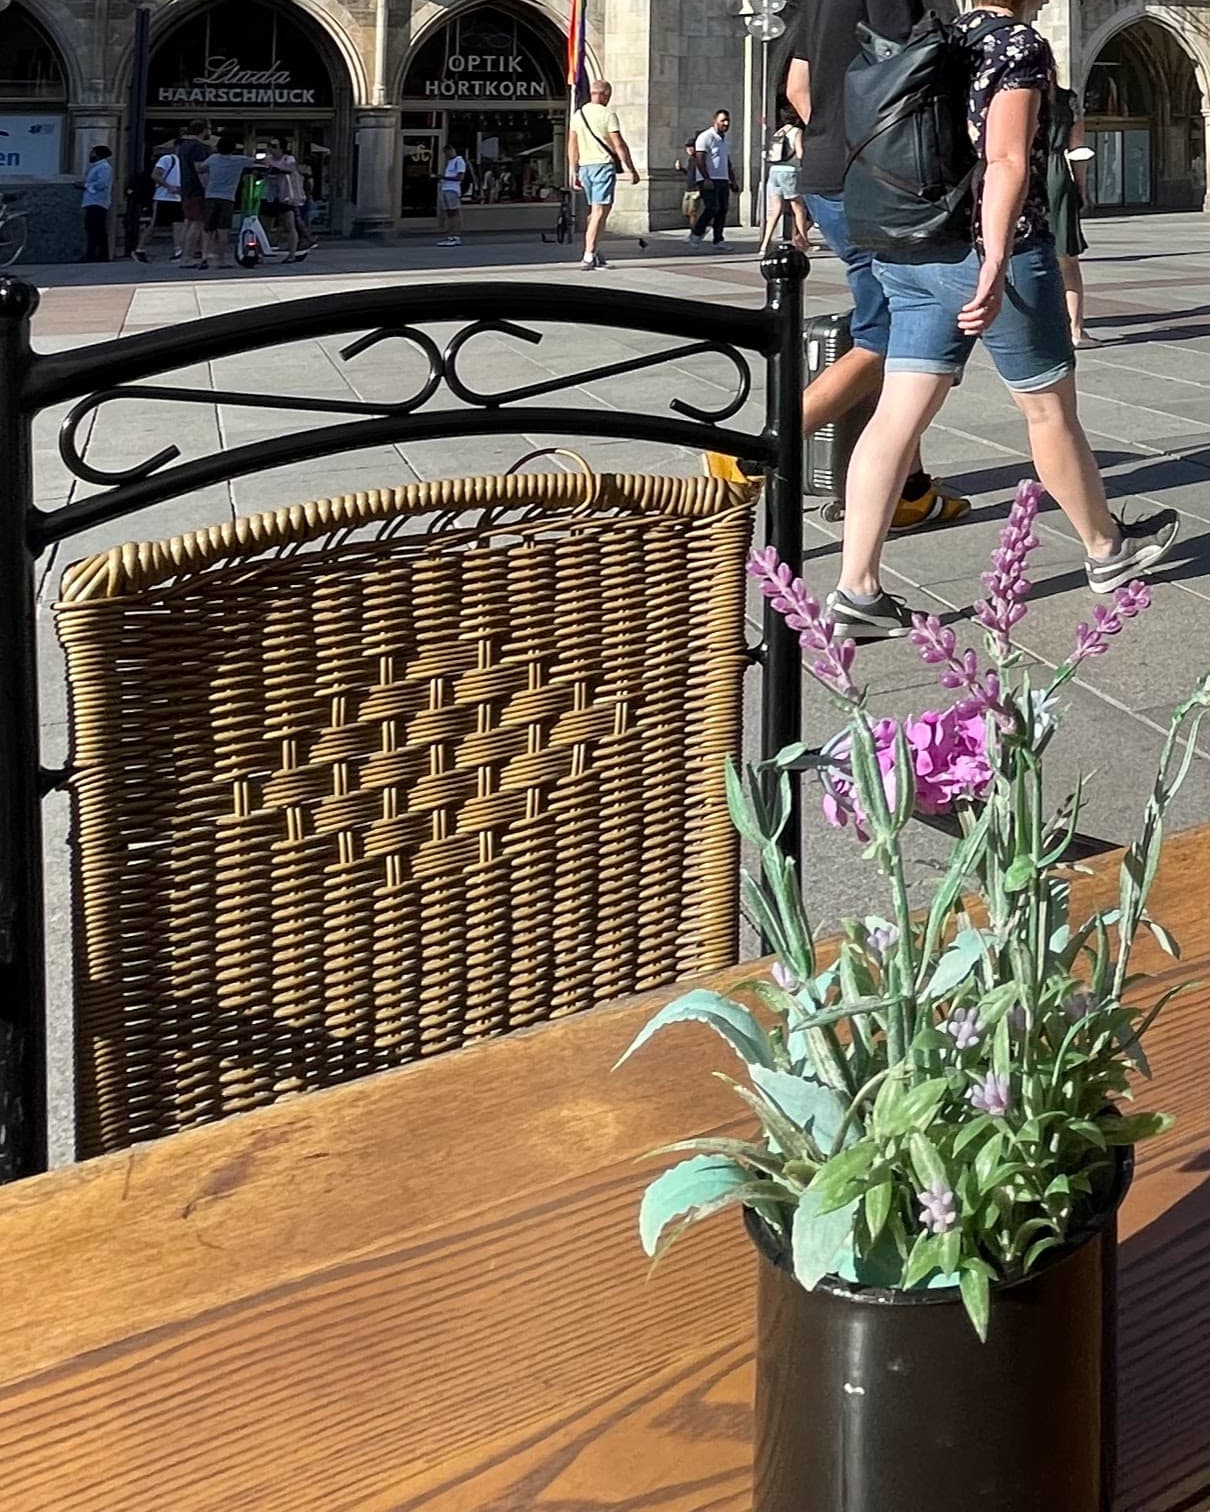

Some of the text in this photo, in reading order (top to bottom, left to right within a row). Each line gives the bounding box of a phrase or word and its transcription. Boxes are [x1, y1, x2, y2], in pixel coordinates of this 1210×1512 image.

[193, 56, 291, 85] Linda
[449, 55, 523, 73] OPTIK
[158, 88, 315, 103] HAARSCHMUCK
